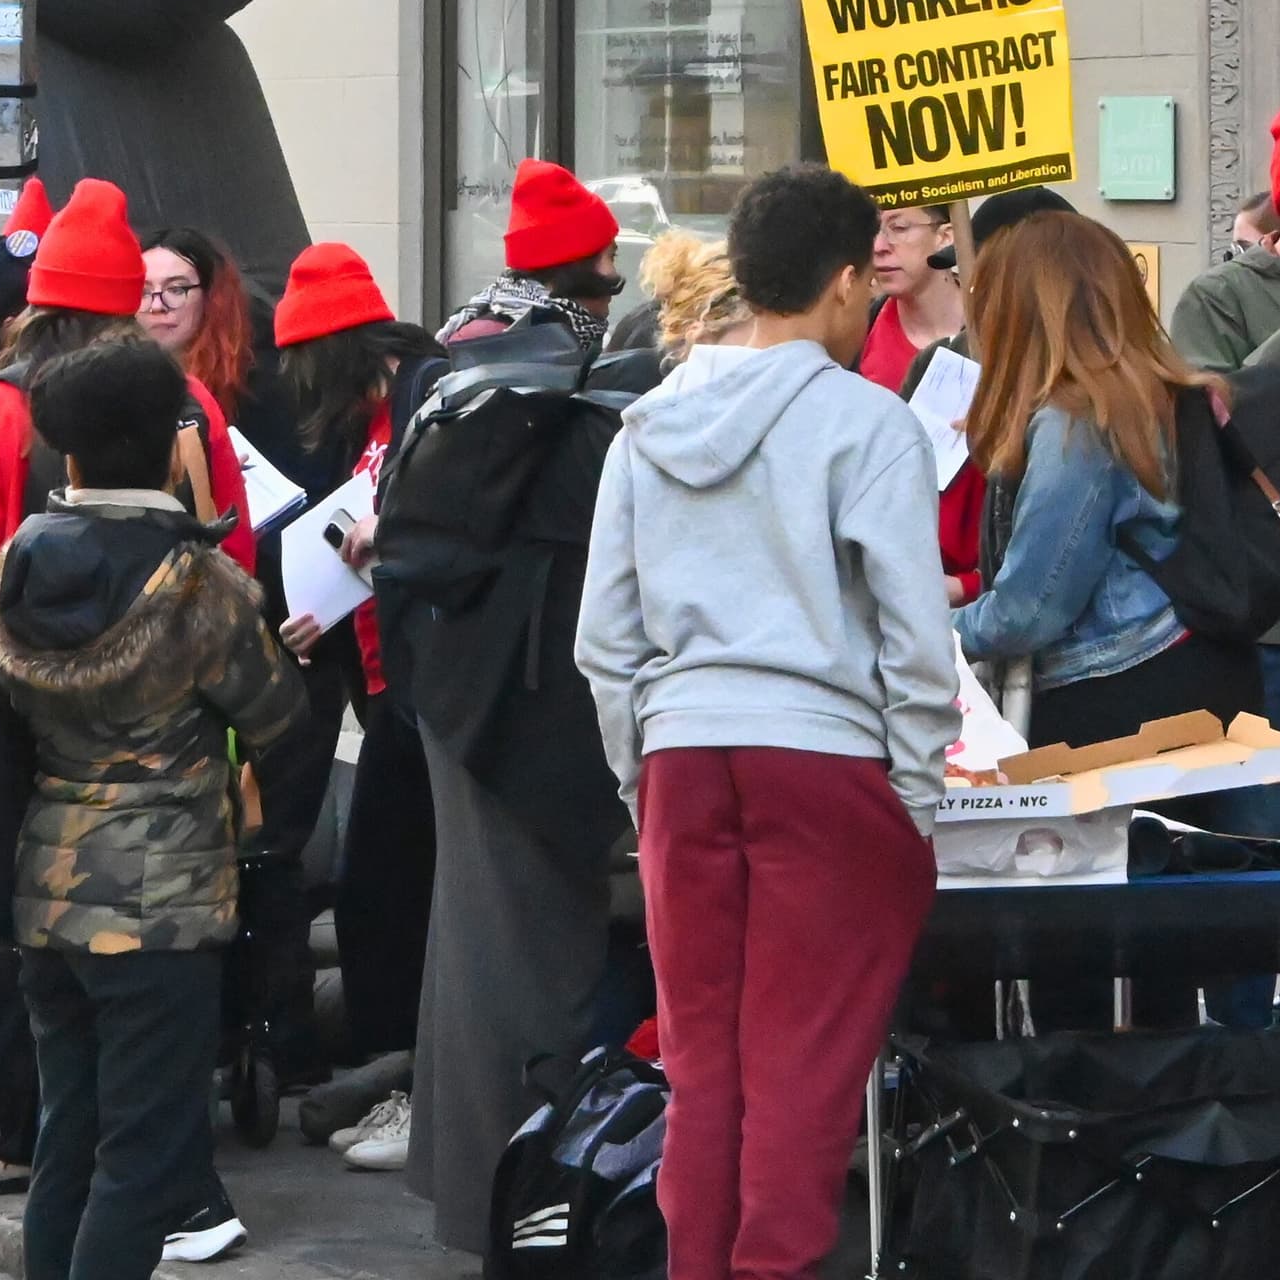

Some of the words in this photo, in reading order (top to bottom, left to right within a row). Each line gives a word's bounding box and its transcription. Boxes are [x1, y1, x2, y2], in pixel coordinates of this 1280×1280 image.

[823, 58, 889, 101] FAIR
[894, 30, 1057, 90] CONTRACT
[865, 82, 1027, 170] NOW!
[900, 189, 918, 201] for
[921, 179, 984, 198] Socialism
[988, 173, 1008, 188] and
[1010, 164, 1067, 183] Liberation
[961, 797, 1004, 810] PIZZA
[1020, 796, 1048, 808] NYC
